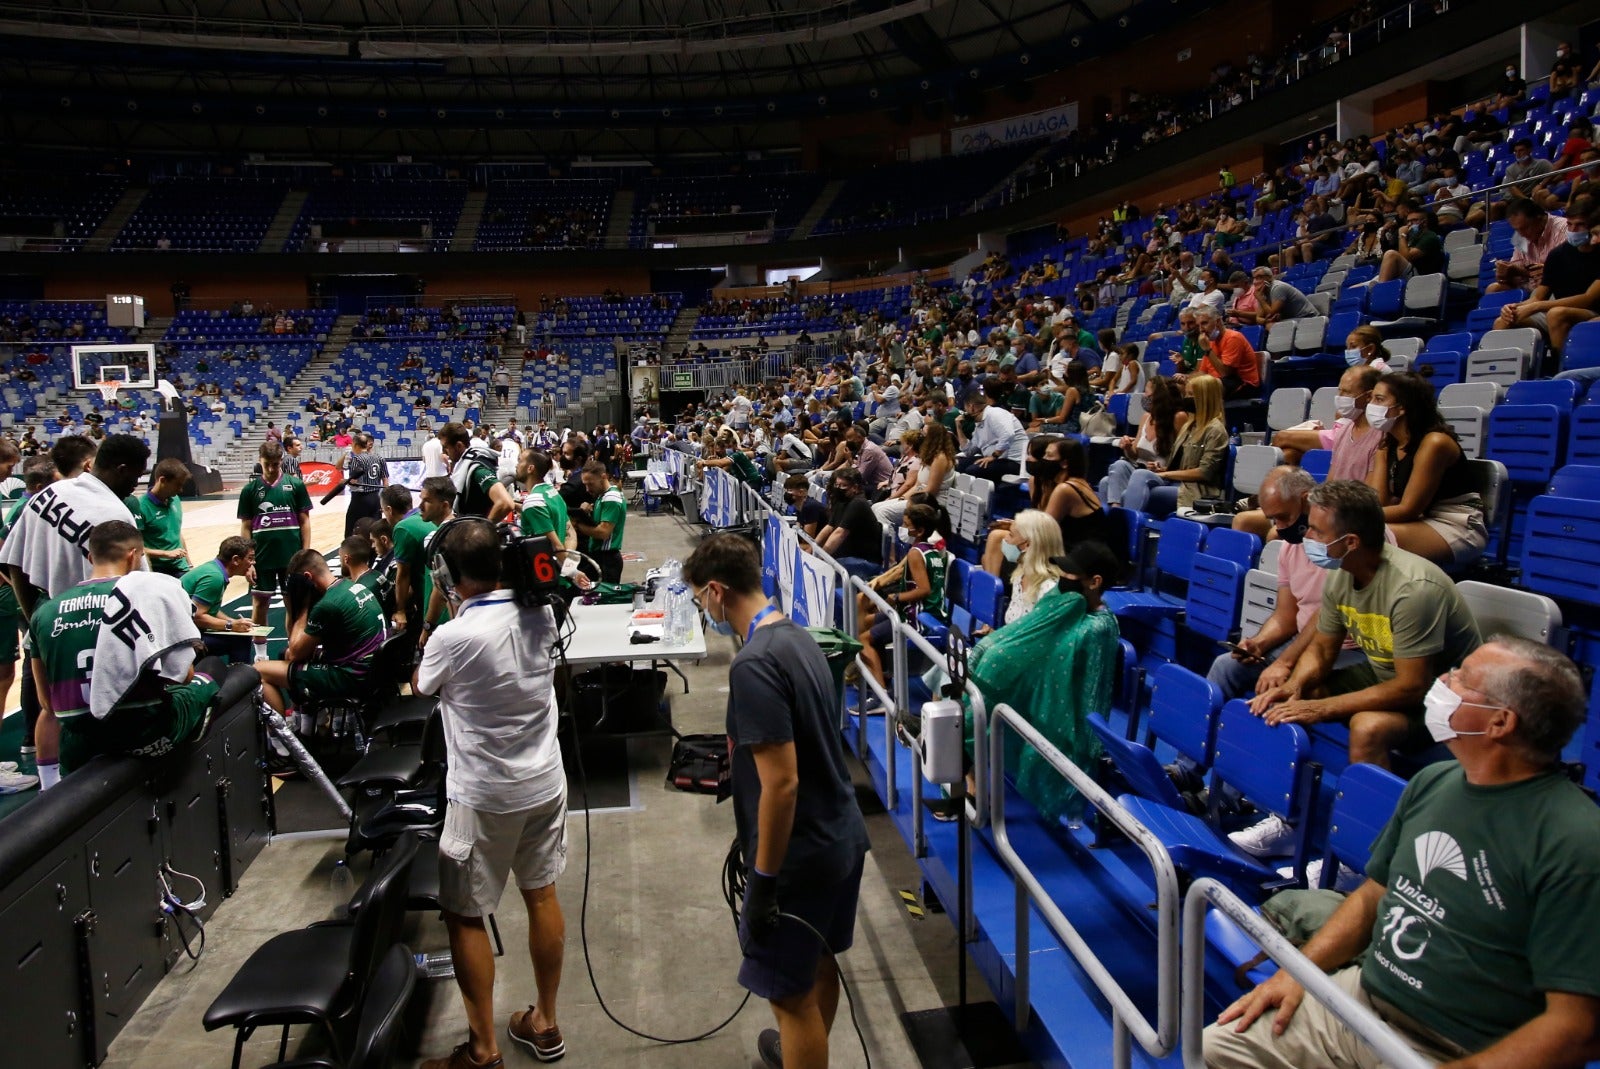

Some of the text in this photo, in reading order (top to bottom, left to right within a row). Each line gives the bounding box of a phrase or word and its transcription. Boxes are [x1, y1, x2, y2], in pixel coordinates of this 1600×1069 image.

[112, 296, 132, 304] 1:18
[502, 449, 514, 459] 17
[533, 552, 555, 583] 6
[1395, 875, 1446, 920] Unicaja
[1389, 964, 1423, 990] UNIDOS
